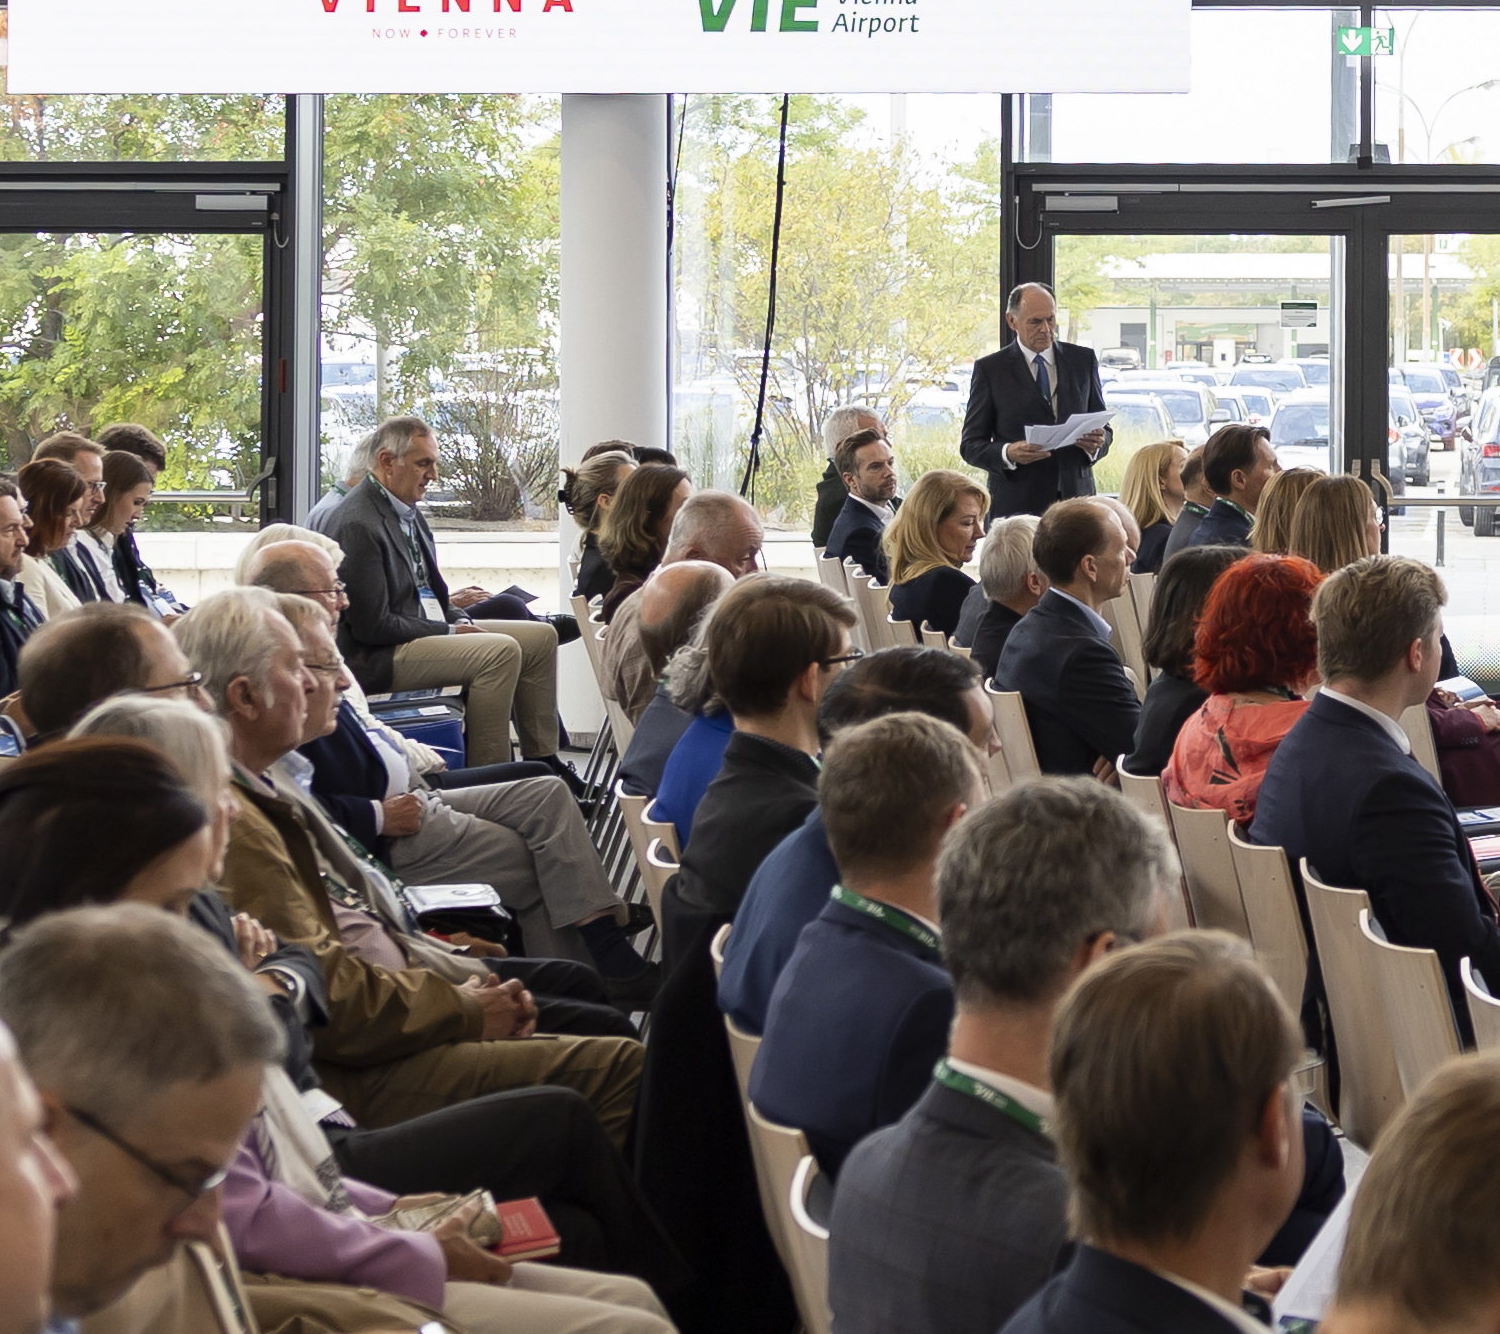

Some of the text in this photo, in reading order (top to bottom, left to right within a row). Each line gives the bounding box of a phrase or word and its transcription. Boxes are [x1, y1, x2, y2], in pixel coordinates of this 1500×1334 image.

[373, 29, 516, 38] NOW FOREVER
[832, 12, 919, 38] Airport
